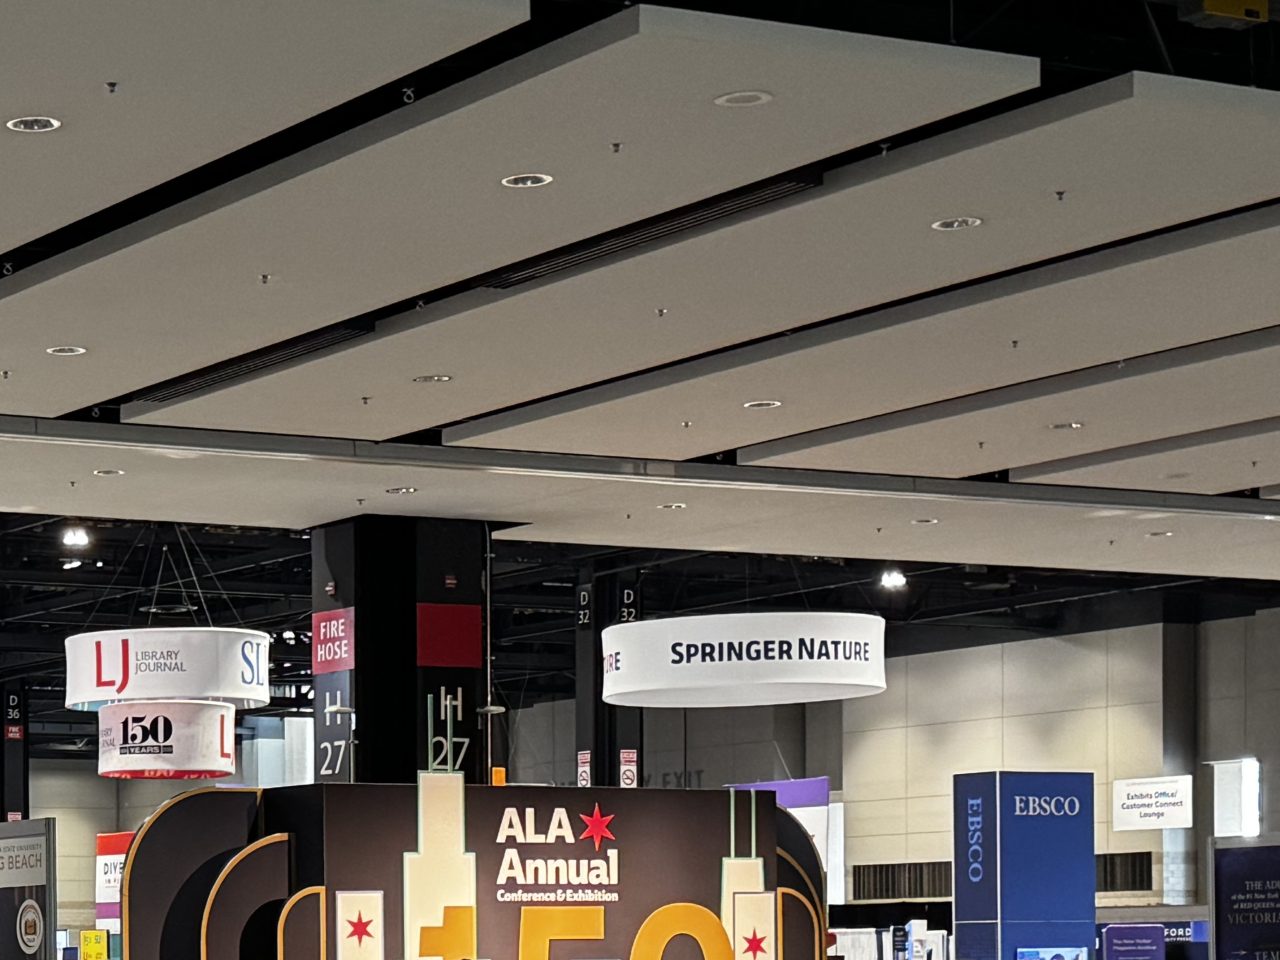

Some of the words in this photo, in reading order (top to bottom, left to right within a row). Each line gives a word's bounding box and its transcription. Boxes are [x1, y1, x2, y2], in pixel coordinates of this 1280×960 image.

[581, 592, 588, 605] D
[624, 590, 634, 603] D
[578, 610, 590, 624] 32
[621, 608, 636, 621] 32
[320, 619, 345, 640] FIRE
[135, 650, 180, 661] LIBRARY
[317, 640, 348, 662] HOSE
[670, 640, 793, 664] SPRINGER
[798, 638, 870, 662] NATURE
[95, 639, 129, 694] LJ
[135, 661, 186, 675] JOURNAL
[241, 640, 267, 686] SL
[9, 695, 18, 706] D
[326, 691, 341, 726] H
[440, 686, 462, 721] H
[7, 709, 20, 719] 36
[119, 715, 173, 745] 150
[130, 746, 160, 754] YEARS
[320, 740, 346, 775] 27
[431, 736, 470, 770] 27
[1014, 795, 1080, 817] EBSCO
[496, 807, 575, 844] ALA
[967, 797, 983, 883] EBSCO
[7, 852, 42, 870] BEACH
[496, 848, 618, 885] Annual
[497, 889, 556, 902] Conference
[557, 889, 565, 901] &
[566, 889, 619, 902] Exhibition
